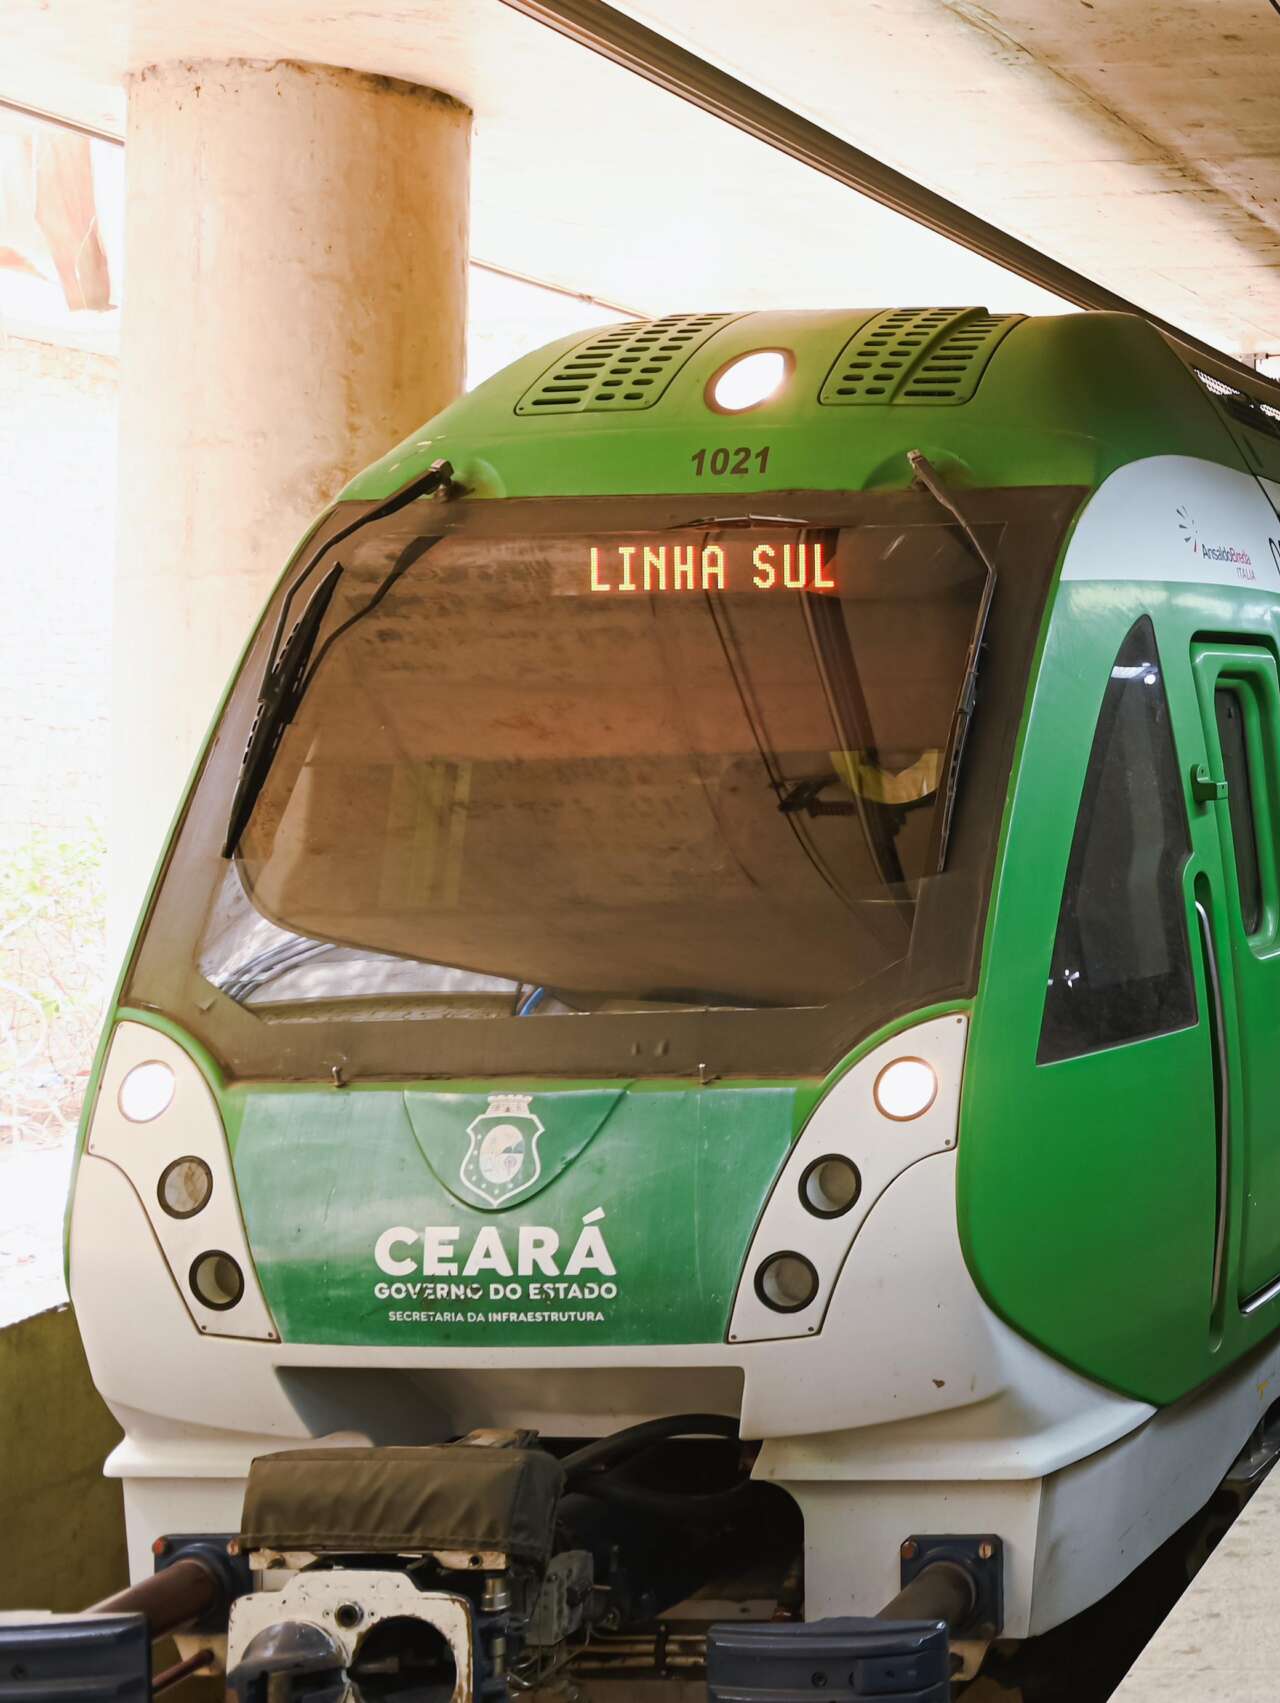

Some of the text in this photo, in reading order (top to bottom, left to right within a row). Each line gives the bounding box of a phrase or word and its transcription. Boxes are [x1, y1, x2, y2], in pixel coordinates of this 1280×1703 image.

[690, 446, 770, 476] 1021
[590, 543, 835, 592] LINHA SUL
[374, 1206, 617, 1277] CEARÁ
[374, 1282, 618, 1300] GOVERNO DO ESTADO
[388, 1311, 605, 1323] SECRETARIA DA INFRAESTRUTURA
